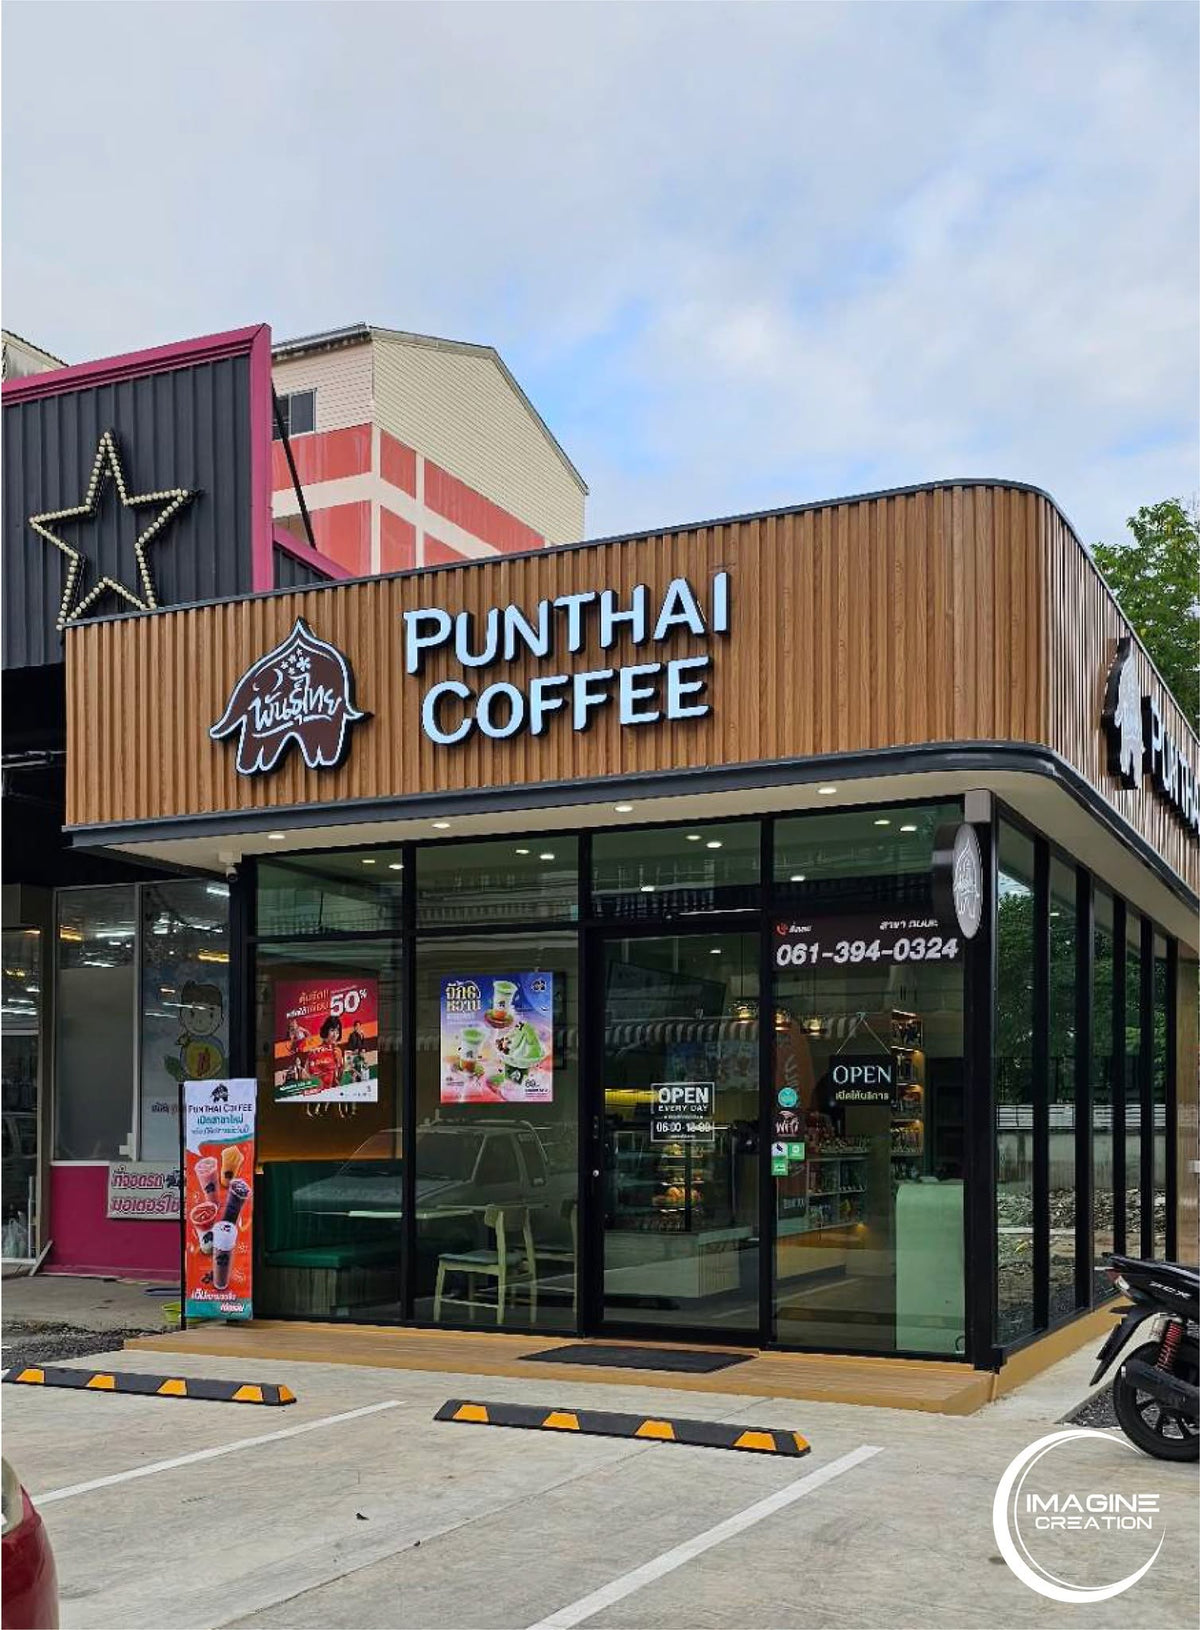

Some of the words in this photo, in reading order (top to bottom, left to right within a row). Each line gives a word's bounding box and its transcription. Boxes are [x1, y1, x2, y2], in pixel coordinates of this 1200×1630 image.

[402, 572, 728, 674] PUNTHAI
[421, 655, 710, 744] COFFEE
[776, 937, 958, 966] 061-394-0324
[833, 1065, 892, 1084] OPEN
[658, 1087, 709, 1104] OPEN
[835, 1089, 889, 1100] เปิดให้บริการ
[112, 1165, 165, 1188] ที่จอดรถ
